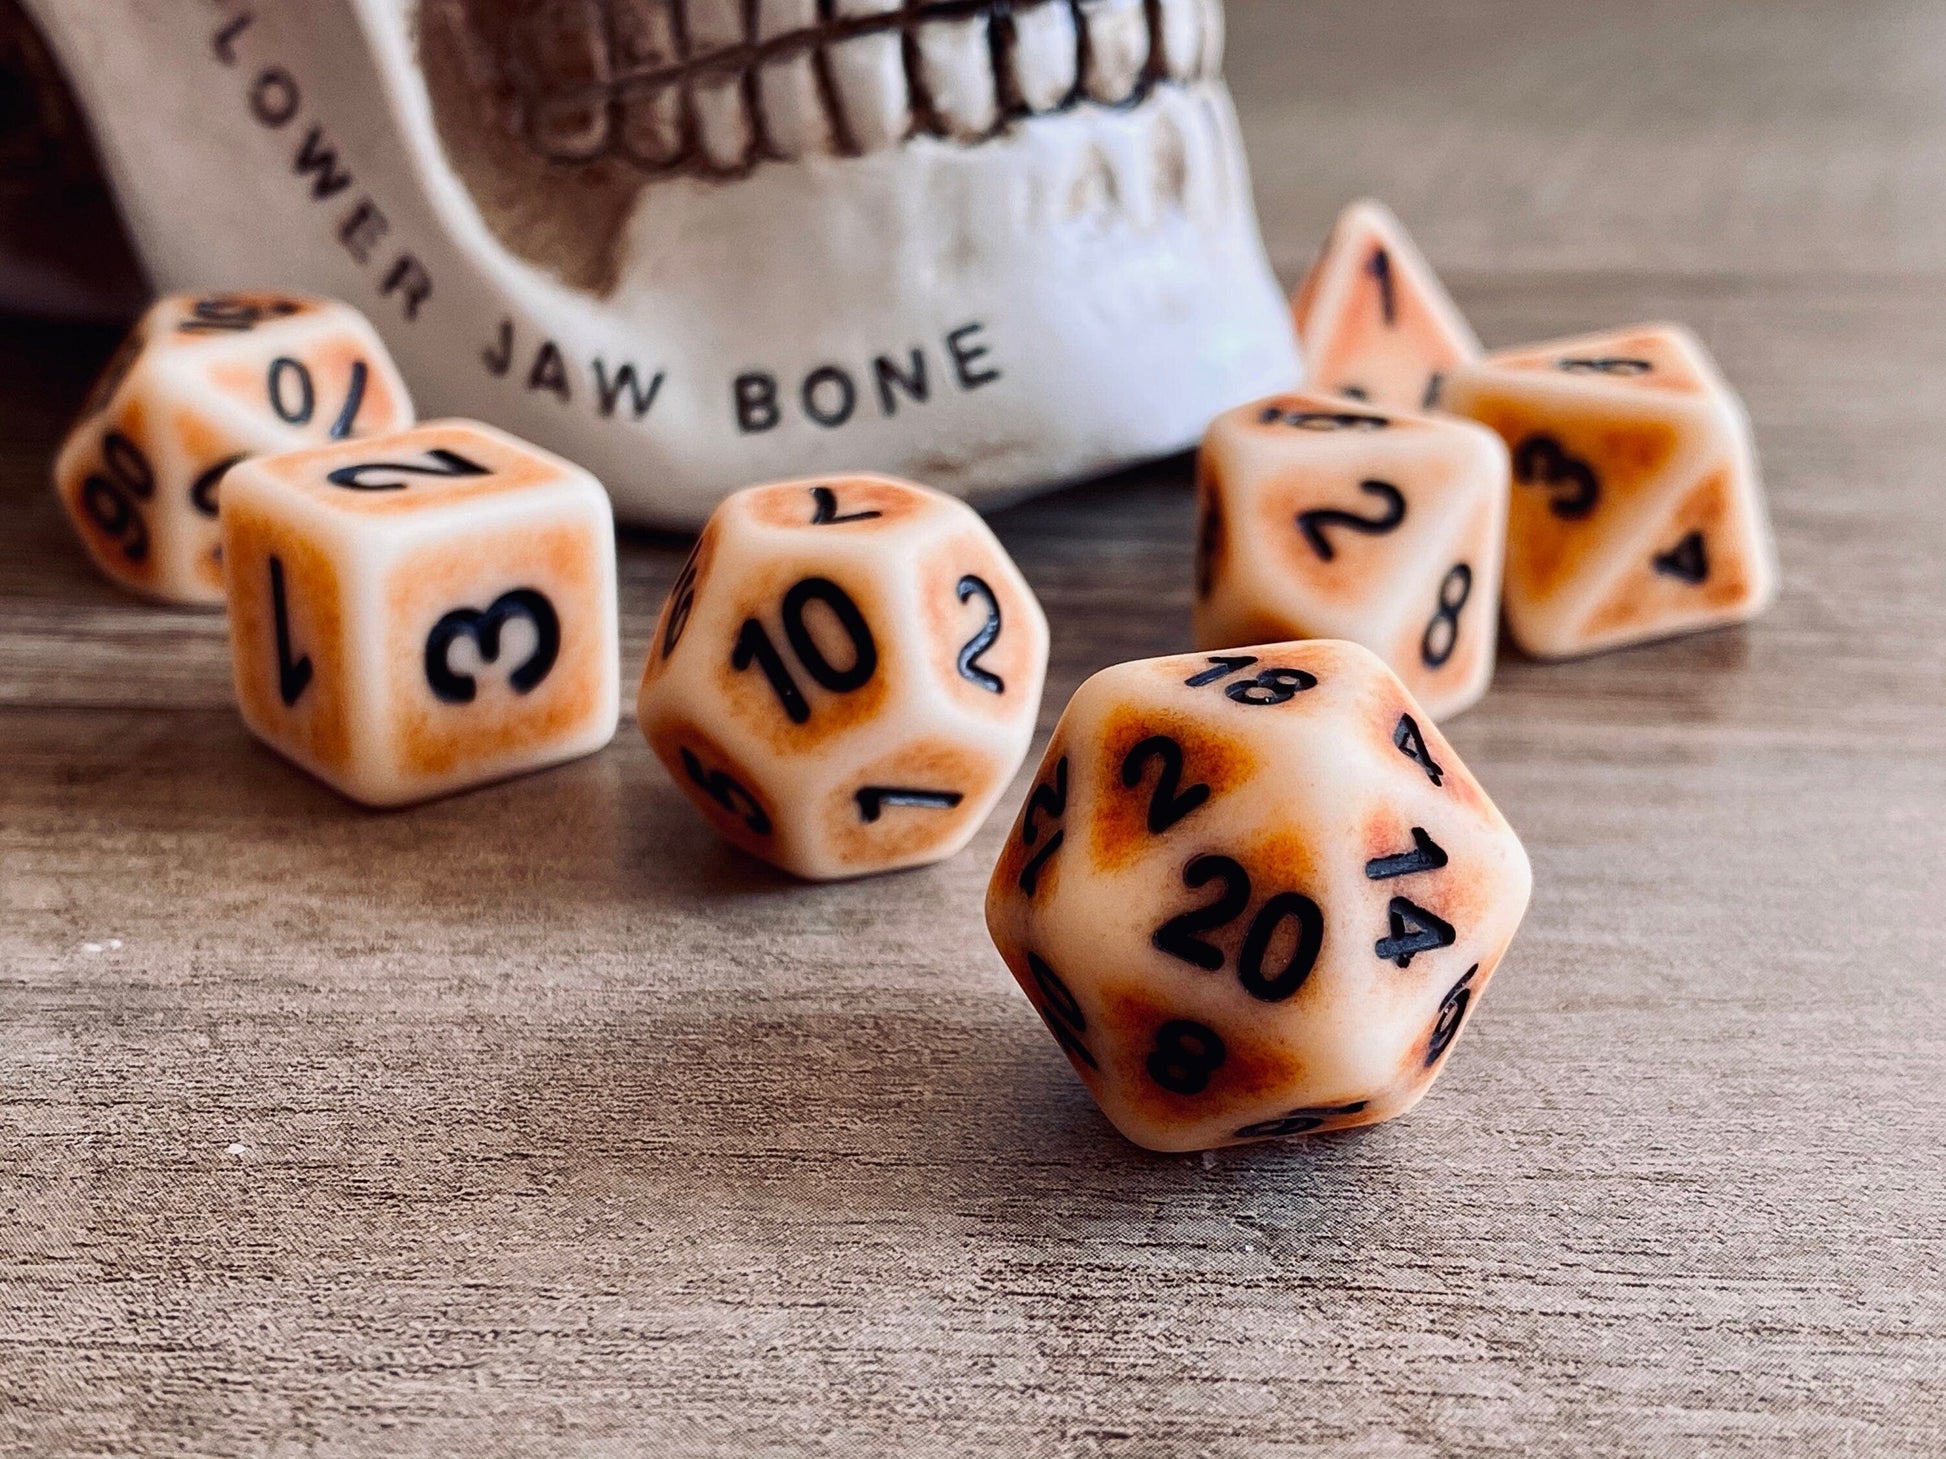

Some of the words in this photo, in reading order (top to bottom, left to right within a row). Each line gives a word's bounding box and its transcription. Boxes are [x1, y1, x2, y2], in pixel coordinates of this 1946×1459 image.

[209, 10, 436, 322] LOWER
[480, 319, 665, 420] JAW
[730, 321, 1006, 437] BONE
[1367, 246, 1397, 326] 1
[326, 448, 495, 492] 2
[1513, 432, 1601, 521] 3
[1296, 481, 1406, 563] 2
[1652, 529, 1708, 585] 4
[268, 552, 314, 708] 1
[424, 587, 562, 706] 3
[730, 576, 878, 725] 10
[956, 574, 1006, 695] 2
[1420, 561, 1472, 670] 8
[1184, 655, 1319, 706] 18
[1121, 735, 1211, 834] 2
[1393, 712, 1444, 788] 4
[853, 785, 964, 824] 1
[1151, 854, 1325, 1003] 20
[1364, 826, 1457, 969] 14
[1145, 1018, 1227, 1095] 8
